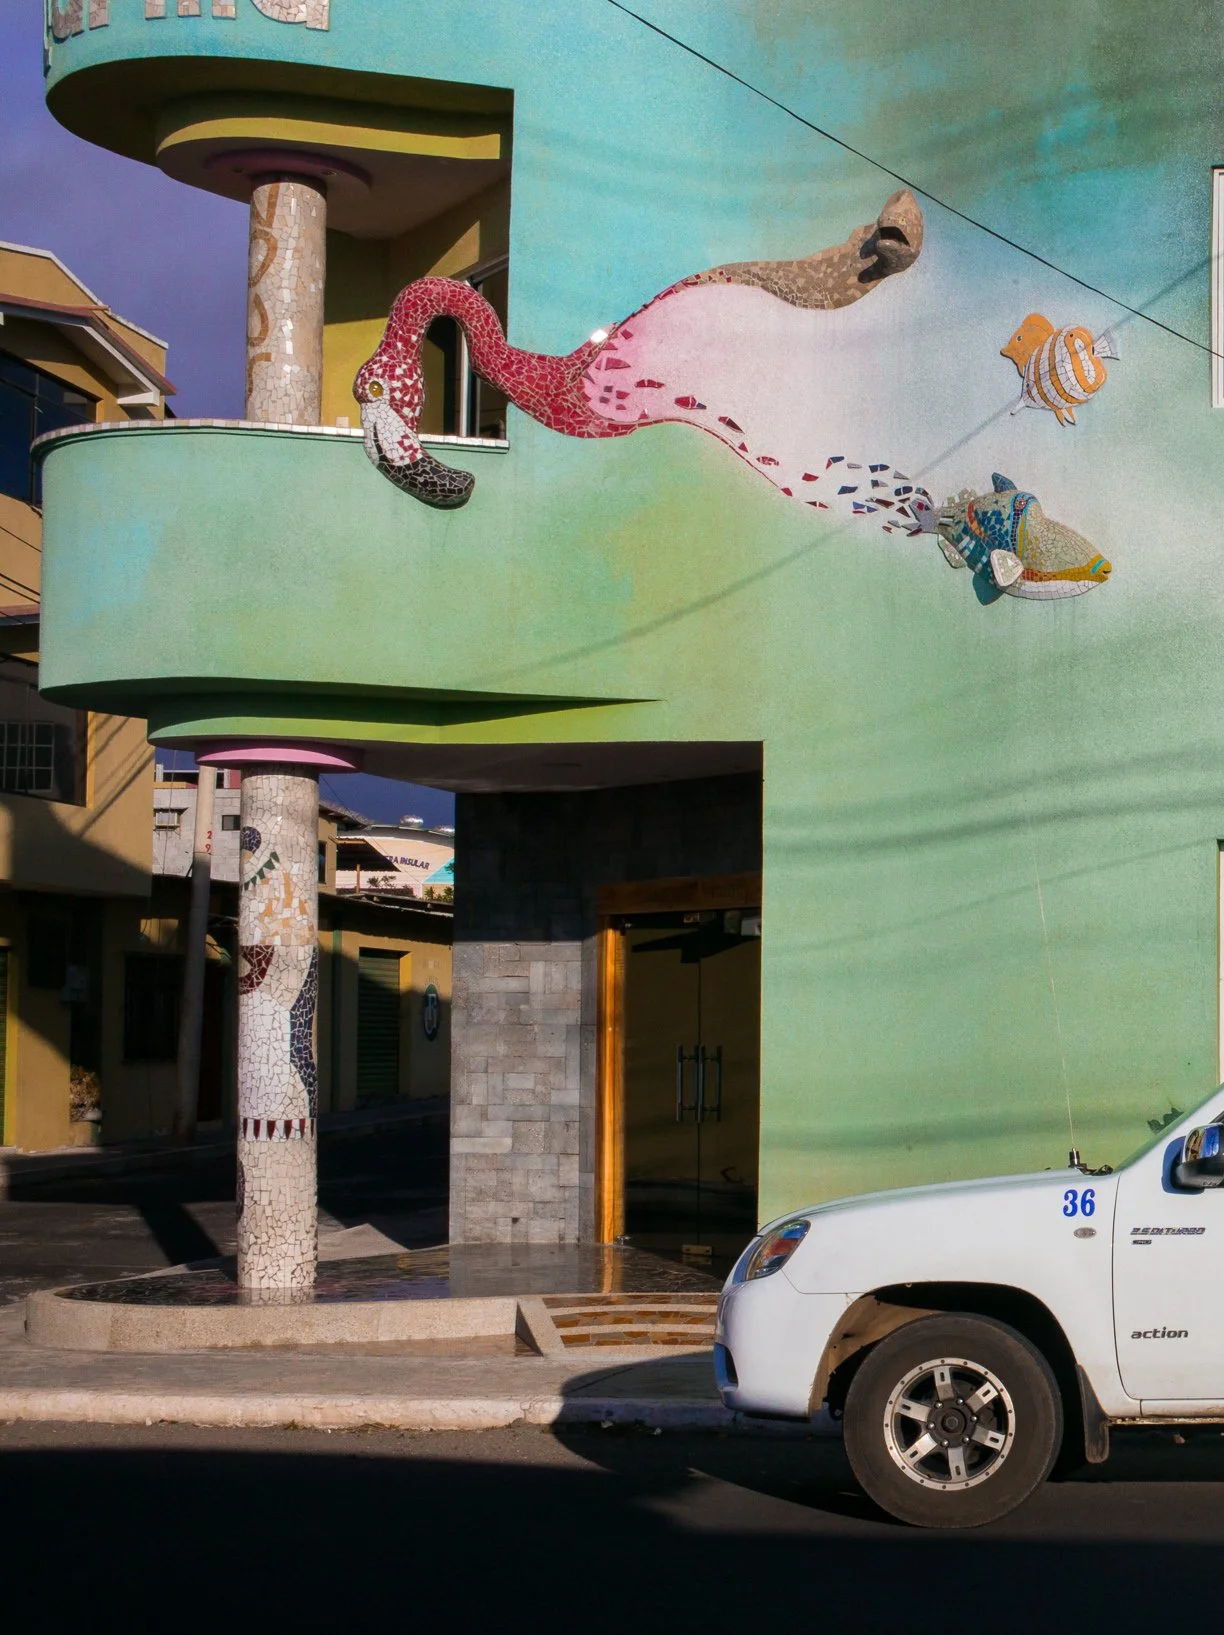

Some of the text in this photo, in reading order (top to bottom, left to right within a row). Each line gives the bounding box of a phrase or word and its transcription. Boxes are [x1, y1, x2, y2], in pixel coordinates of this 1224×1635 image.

[400, 857, 430, 870] INSULAR
[1063, 1188, 1096, 1217] 36
[1131, 1326, 1189, 1339] action
